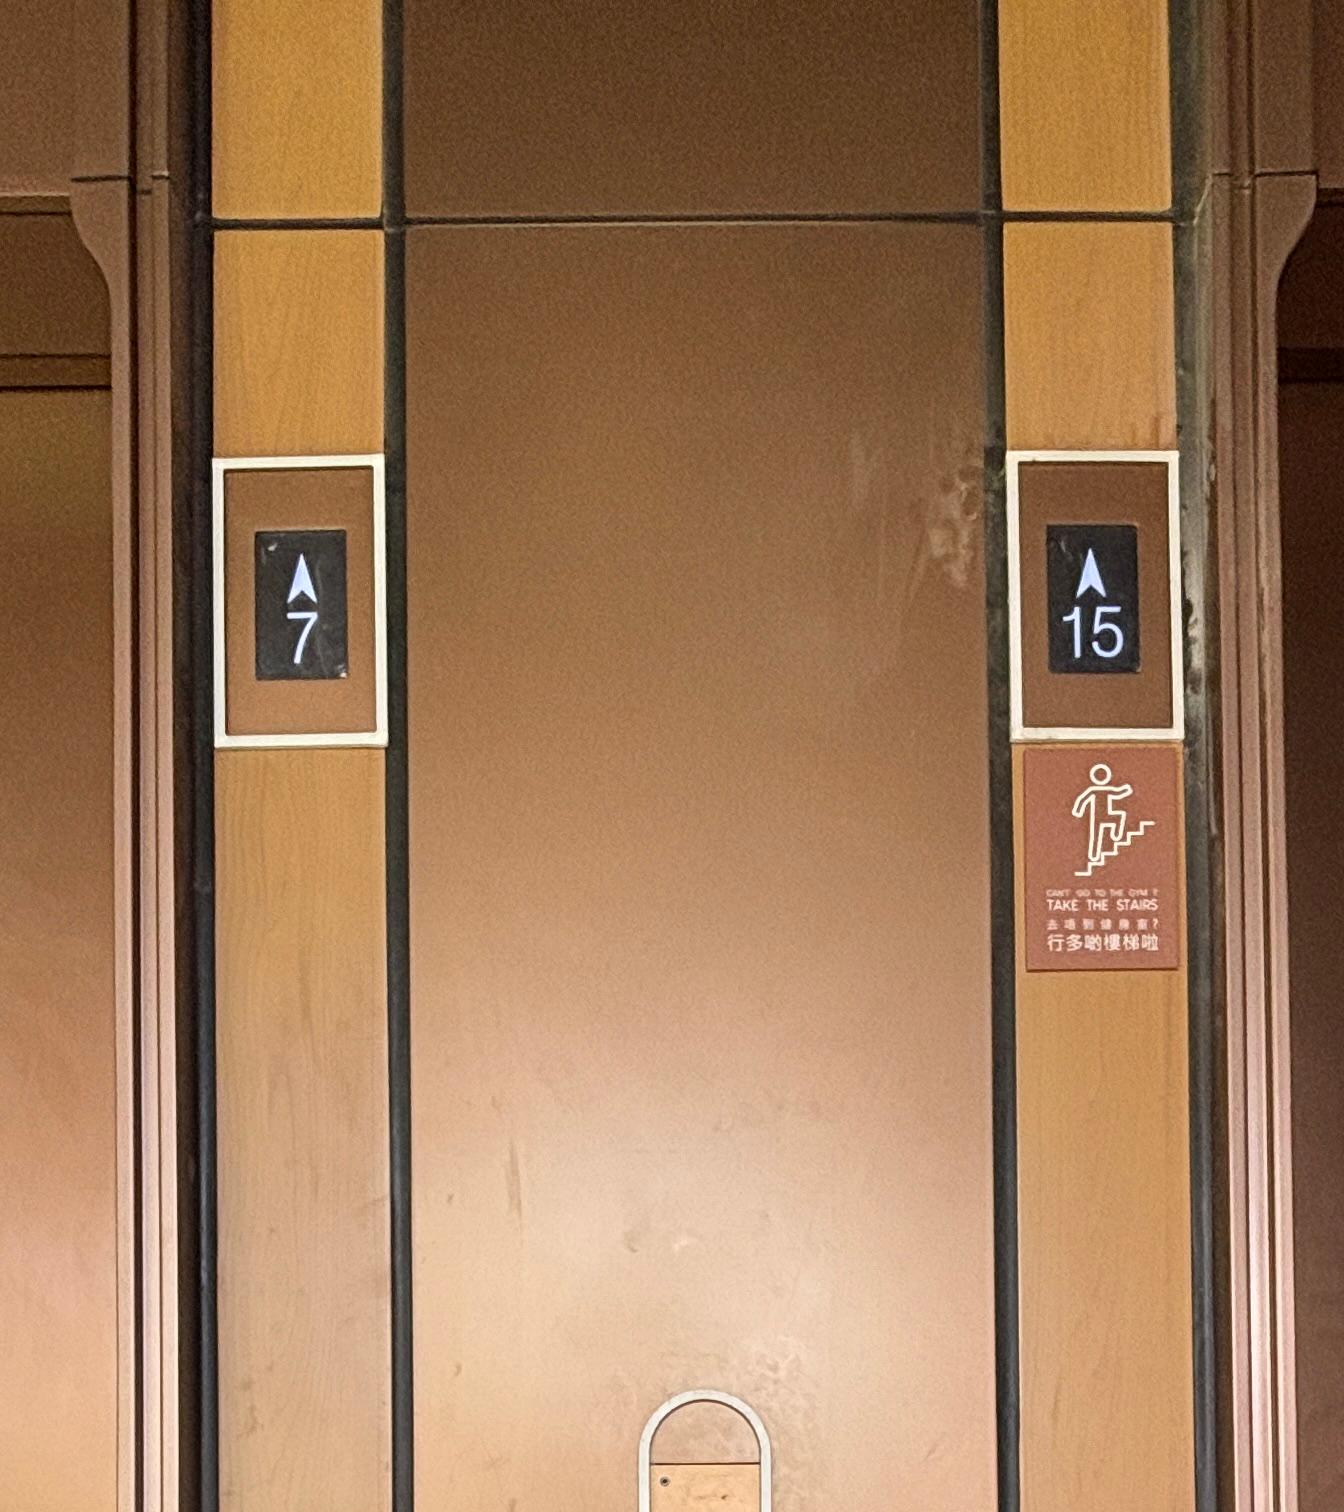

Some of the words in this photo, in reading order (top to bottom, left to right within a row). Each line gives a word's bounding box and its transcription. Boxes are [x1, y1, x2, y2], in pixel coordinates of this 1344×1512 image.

[286, 611, 318, 664] 7
[1062, 606, 1124, 659] 15
[1047, 899, 1078, 911] TAKE
[1086, 899, 1109, 911] THE
[1116, 899, 1159, 911] STAIRS
[1047, 933, 1159, 952] 行多啲樓梯啦
